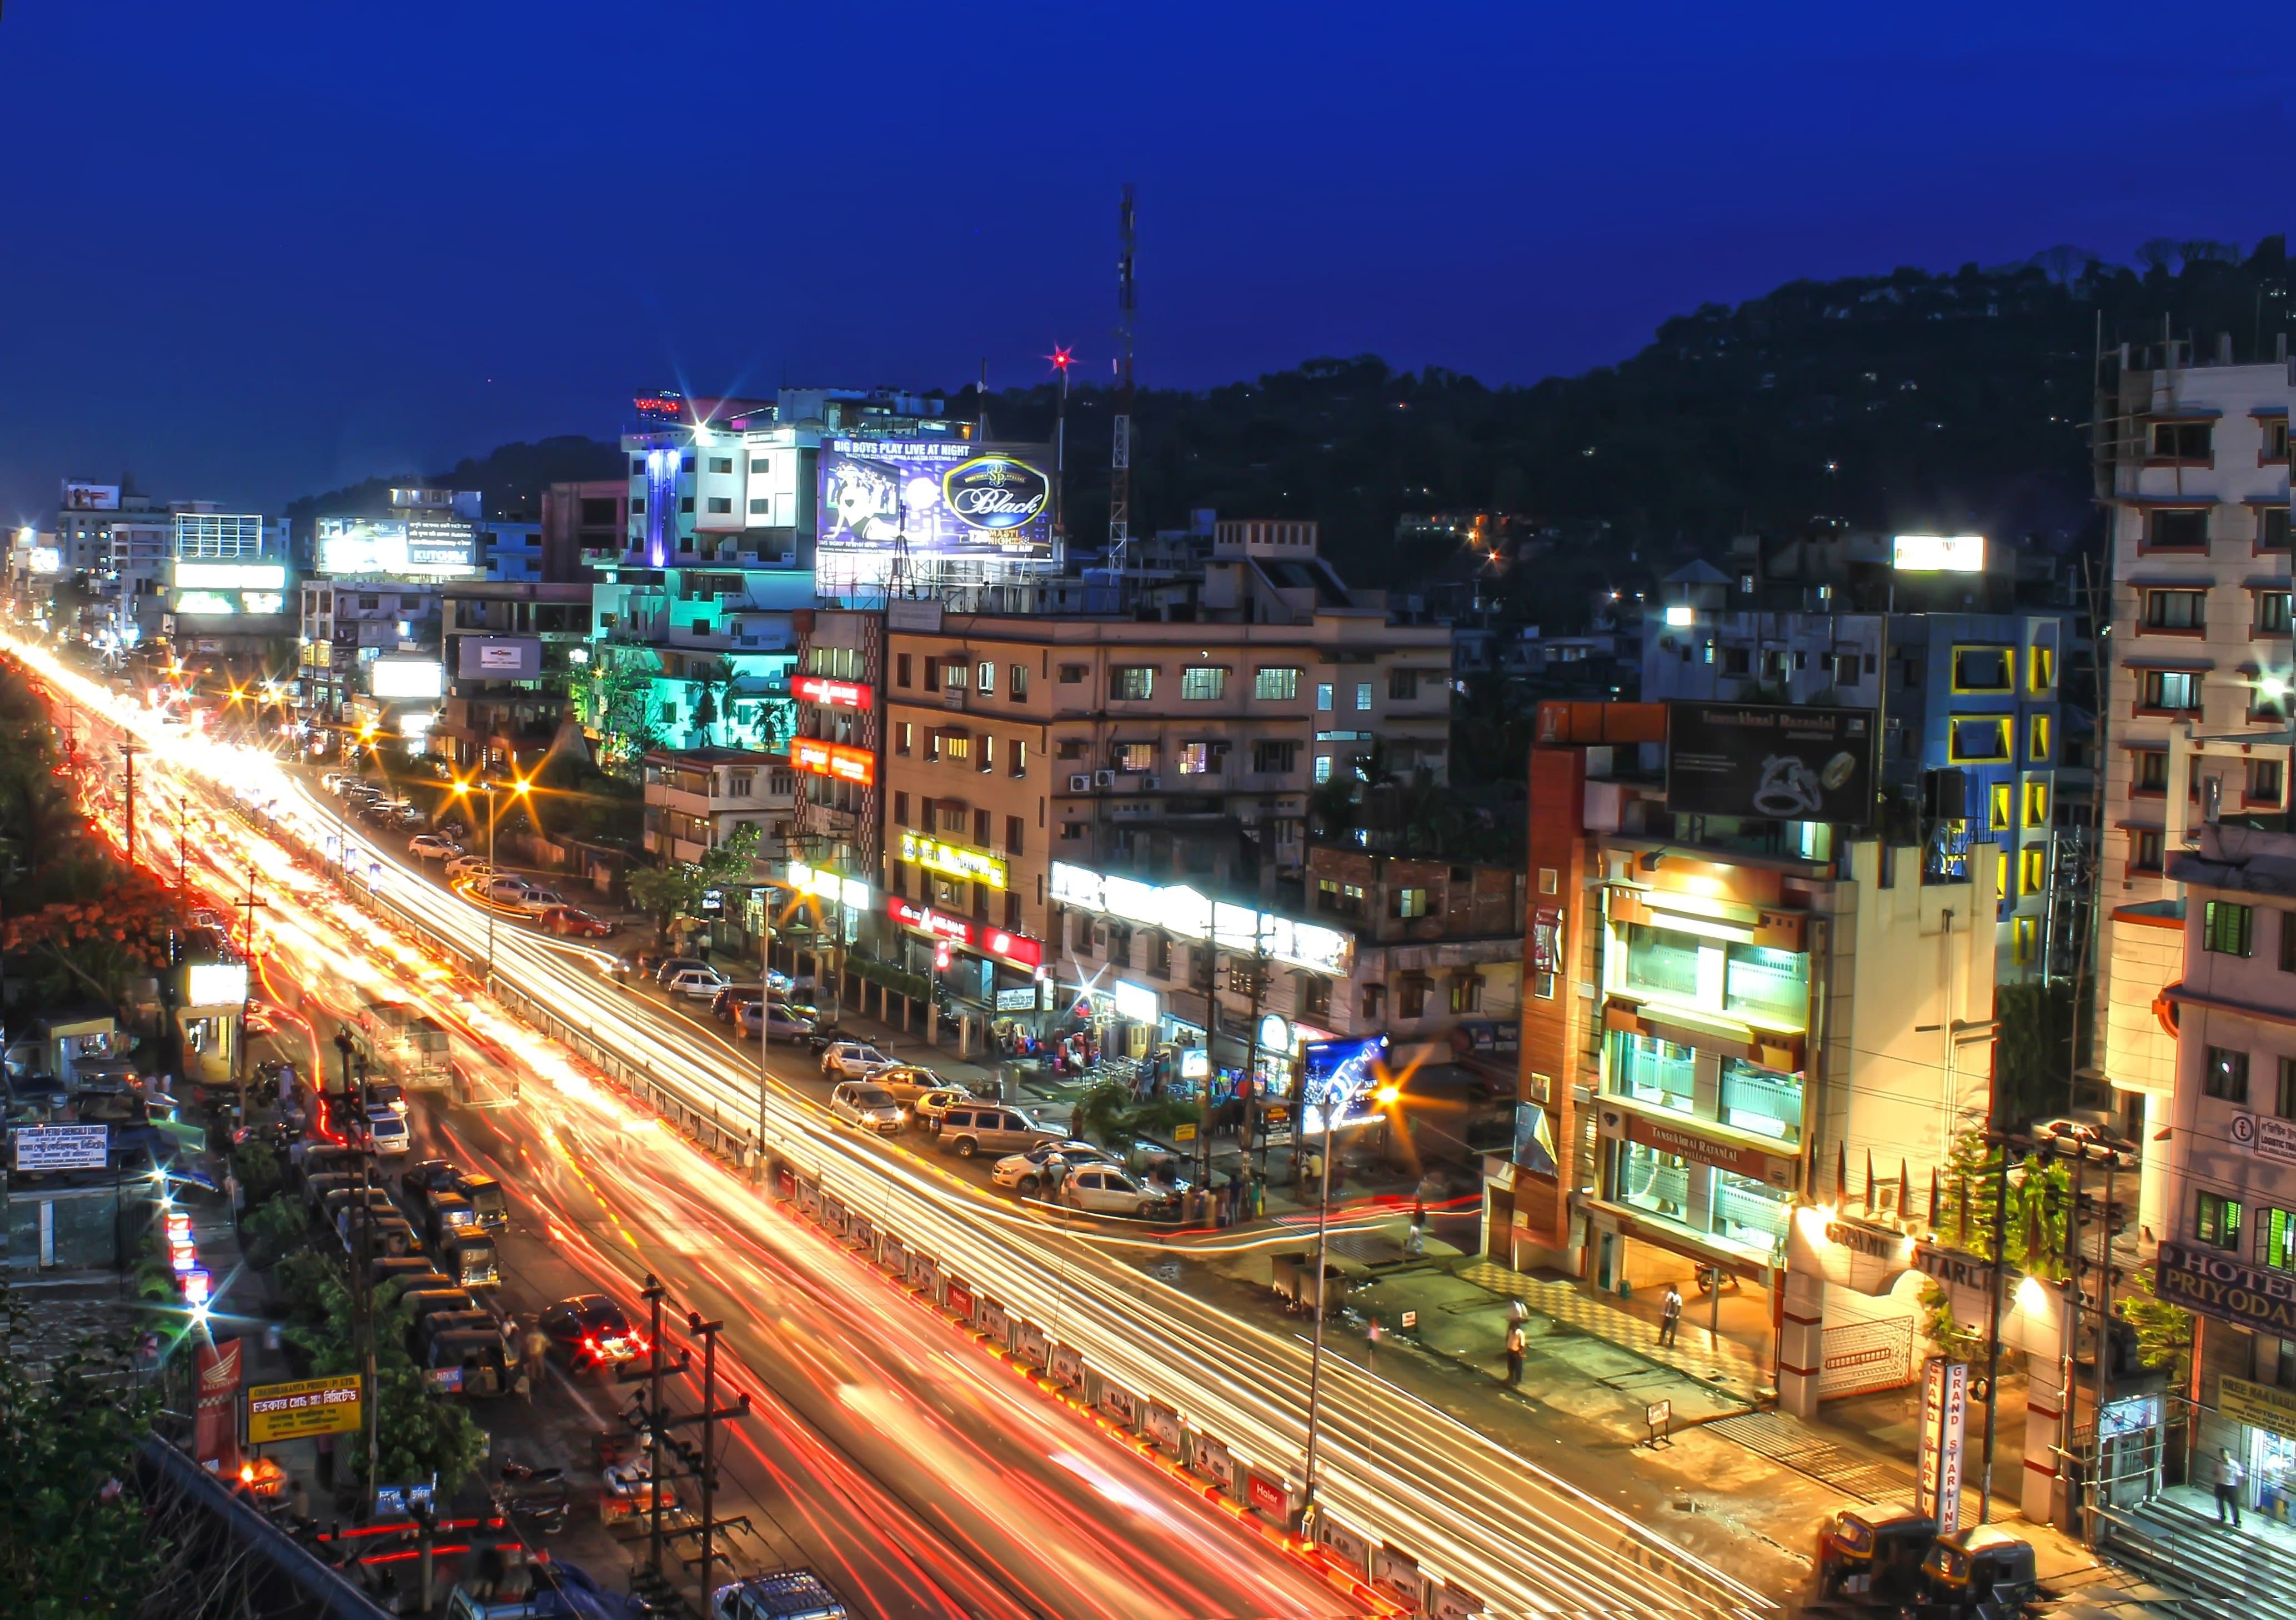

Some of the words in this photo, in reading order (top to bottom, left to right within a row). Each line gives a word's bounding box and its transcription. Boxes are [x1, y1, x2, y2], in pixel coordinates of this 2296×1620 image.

[834, 440, 850, 452] BIG
[853, 442, 877, 453] BOYS
[879, 443, 903, 455] PLAY
[905, 444, 926, 456] LIVE
[927, 444, 939, 456] AT
[941, 446, 970, 457] NIGHT
[954, 487, 1043, 514] Black
[989, 529, 1013, 538] MASTI
[2261, 1136, 2284, 1148] LOGISTIC
[1911, 1244, 2016, 1300] STARLIE
[2165, 1268, 2296, 1327] PRIYODA
[203, 1377, 239, 1391] HONDA
[1928, 1363, 1938, 1422] GRAND
[1951, 1367, 1962, 1425] GRAND
[1256, 1483, 1277, 1503] Haier
[1944, 1439, 1957, 1533] STARLINE
